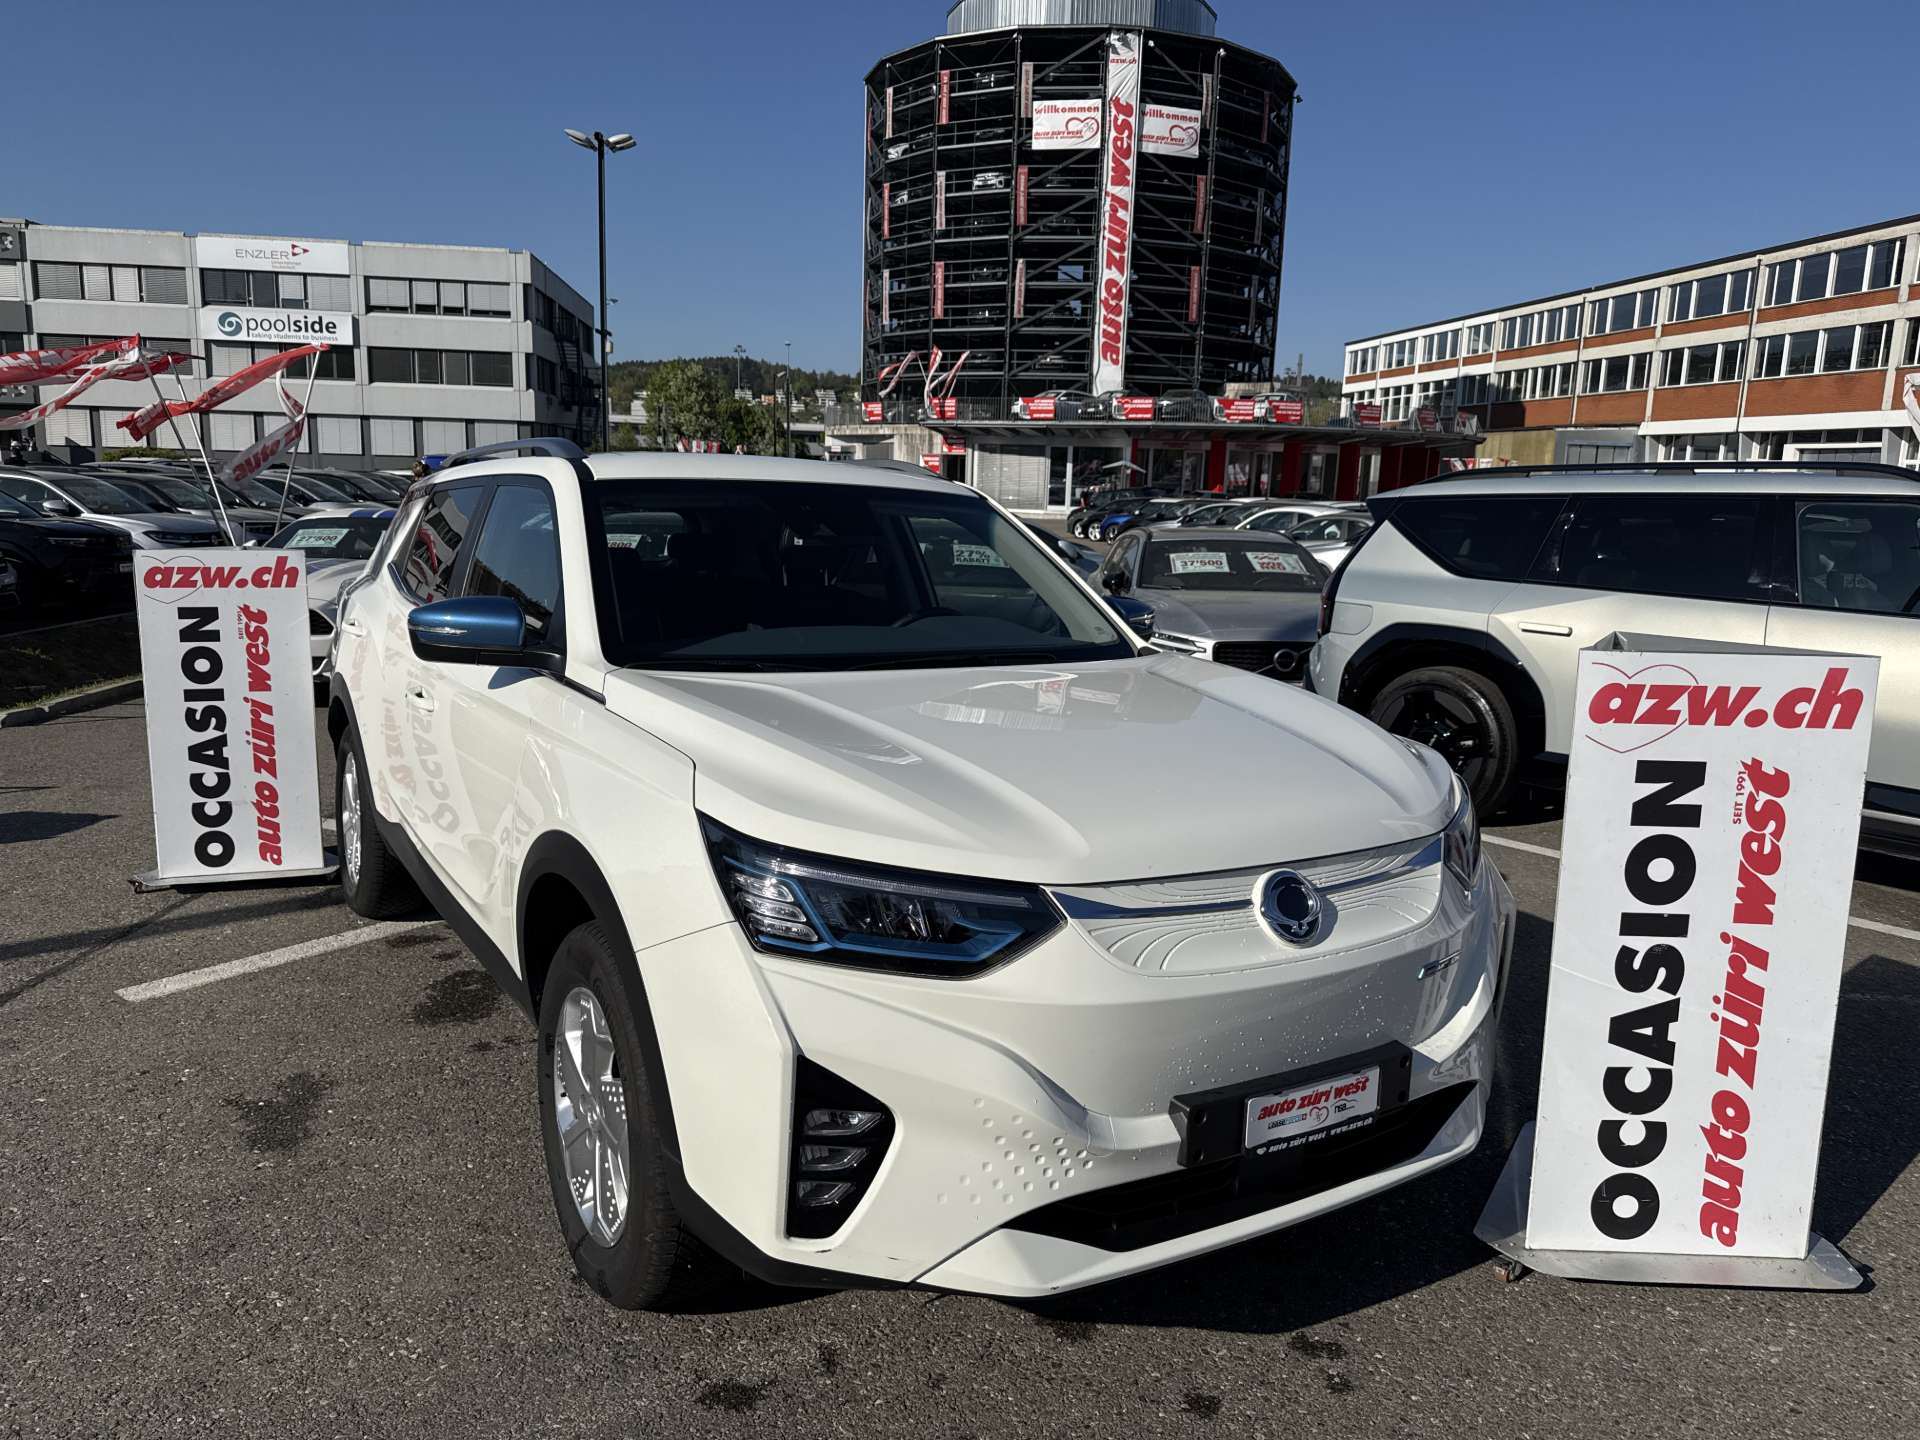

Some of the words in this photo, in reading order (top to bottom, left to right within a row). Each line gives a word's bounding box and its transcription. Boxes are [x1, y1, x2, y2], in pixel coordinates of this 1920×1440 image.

[1035, 105, 1099, 114] willkommen
[1141, 109, 1199, 123] willkommen
[1109, 96, 1134, 188] west
[235, 248, 290, 260] ENZLER
[1105, 191, 1134, 276] züri
[246, 314, 337, 338] poolside
[311, 334, 338, 342] business
[1100, 277, 1124, 366] auto
[143, 556, 300, 589] azw.ch
[955, 550, 991, 558] 27%
[1180, 559, 1224, 567] 37'500
[237, 603, 273, 692] west
[1589, 667, 1865, 731] azw.ch
[177, 606, 236, 868] OCCASION
[243, 696, 278, 780] züri
[1735, 770, 1748, 797] 1991
[250, 780, 283, 866] auto
[1732, 798, 1744, 826] SEIT
[1732, 757, 1791, 926] west
[1590, 759, 1708, 1241] OCCASION
[1711, 932, 1770, 1091] züri
[1258, 1098, 1297, 1120] auto
[1297, 1086, 1333, 1110] züri
[1334, 1075, 1370, 1100] west
[1268, 1141, 1288, 1153] auto
[1308, 1131, 1327, 1142] west
[1700, 1090, 1752, 1249] auto
